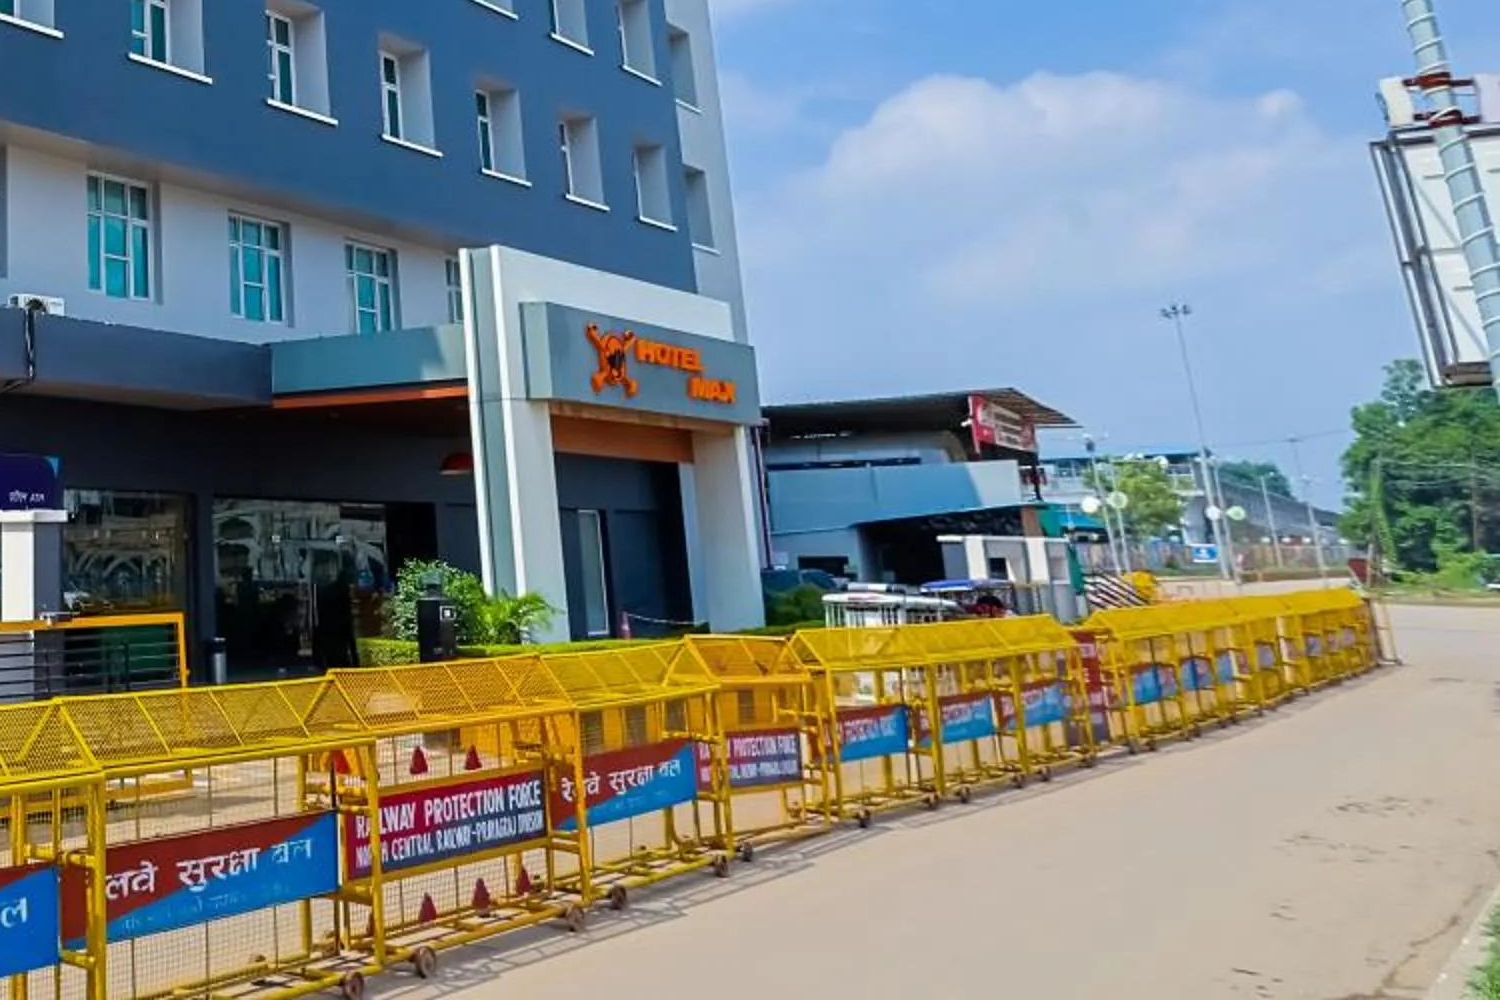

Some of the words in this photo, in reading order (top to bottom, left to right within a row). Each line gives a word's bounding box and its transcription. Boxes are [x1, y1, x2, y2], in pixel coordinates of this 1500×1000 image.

[634, 340, 703, 373] HOTEL
[355, 801, 417, 839] RALWAY
[423, 788, 505, 827] PROTECTION
[508, 779, 542, 810] FORCE
[105, 861, 159, 900] लवे
[175, 847, 260, 892] सुरक्षा
